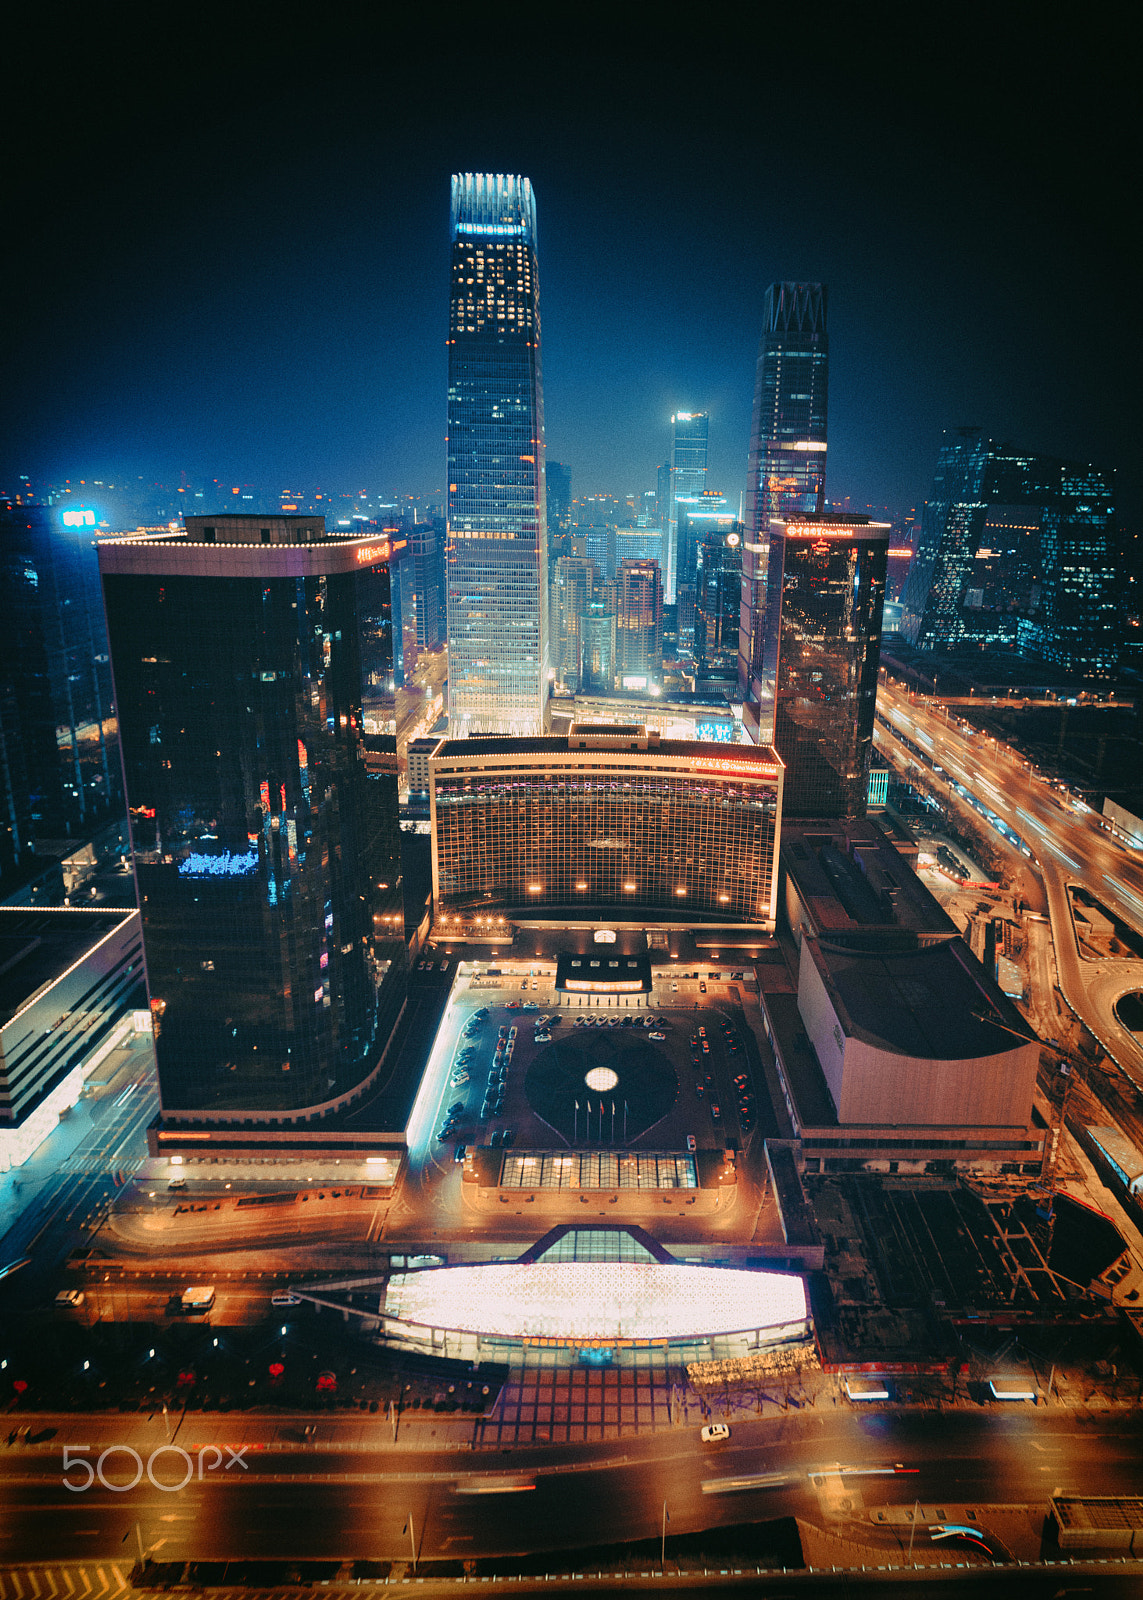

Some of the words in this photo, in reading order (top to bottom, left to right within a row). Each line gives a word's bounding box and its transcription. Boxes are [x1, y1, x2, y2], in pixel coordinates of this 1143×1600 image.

[822, 528, 837, 536] China
[837, 529, 853, 537] World
[730, 763, 745, 771] China
[745, 765, 762, 773] World
